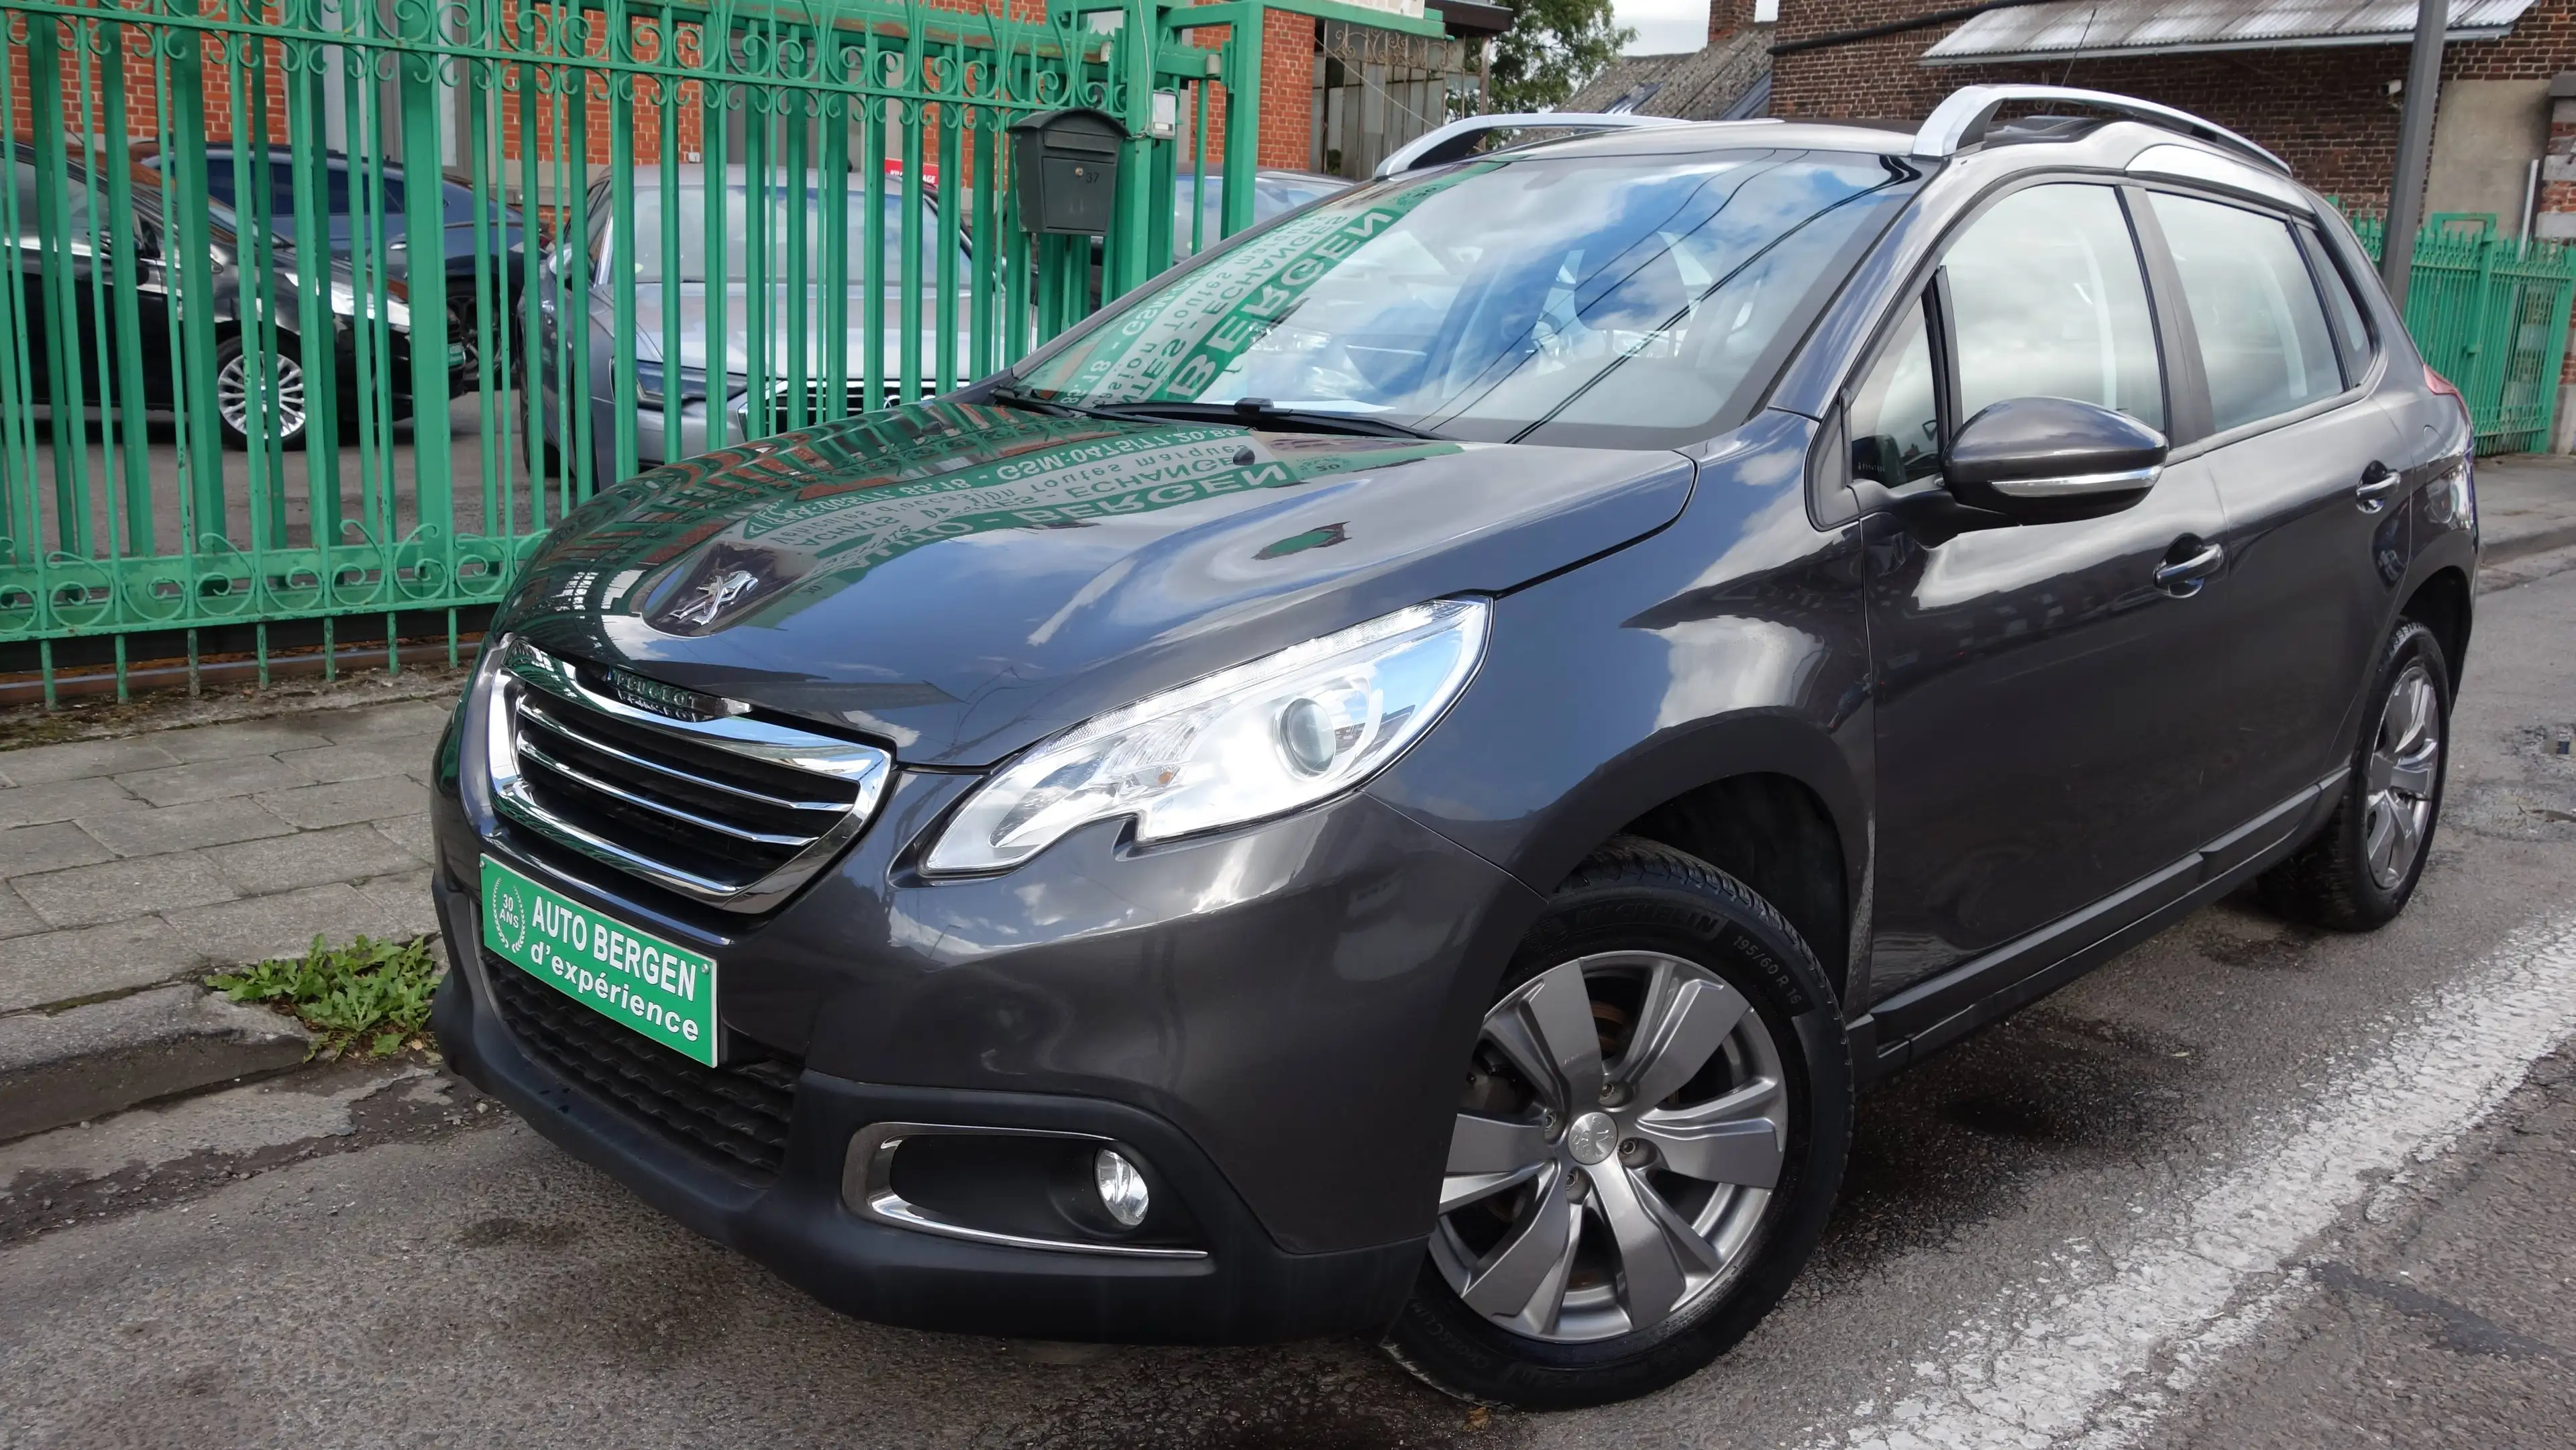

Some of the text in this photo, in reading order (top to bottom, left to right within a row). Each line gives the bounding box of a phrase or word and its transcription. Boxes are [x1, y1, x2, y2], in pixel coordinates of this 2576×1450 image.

[1085, 172, 1099, 184] 37
[499, 911, 519, 929] ANS
[502, 893, 513, 912] 30
[532, 896, 696, 1002] AUTO BERGEN
[1733, 935, 1803, 1004] 195/60 R 16
[531, 941, 699, 1041] d'expérience
